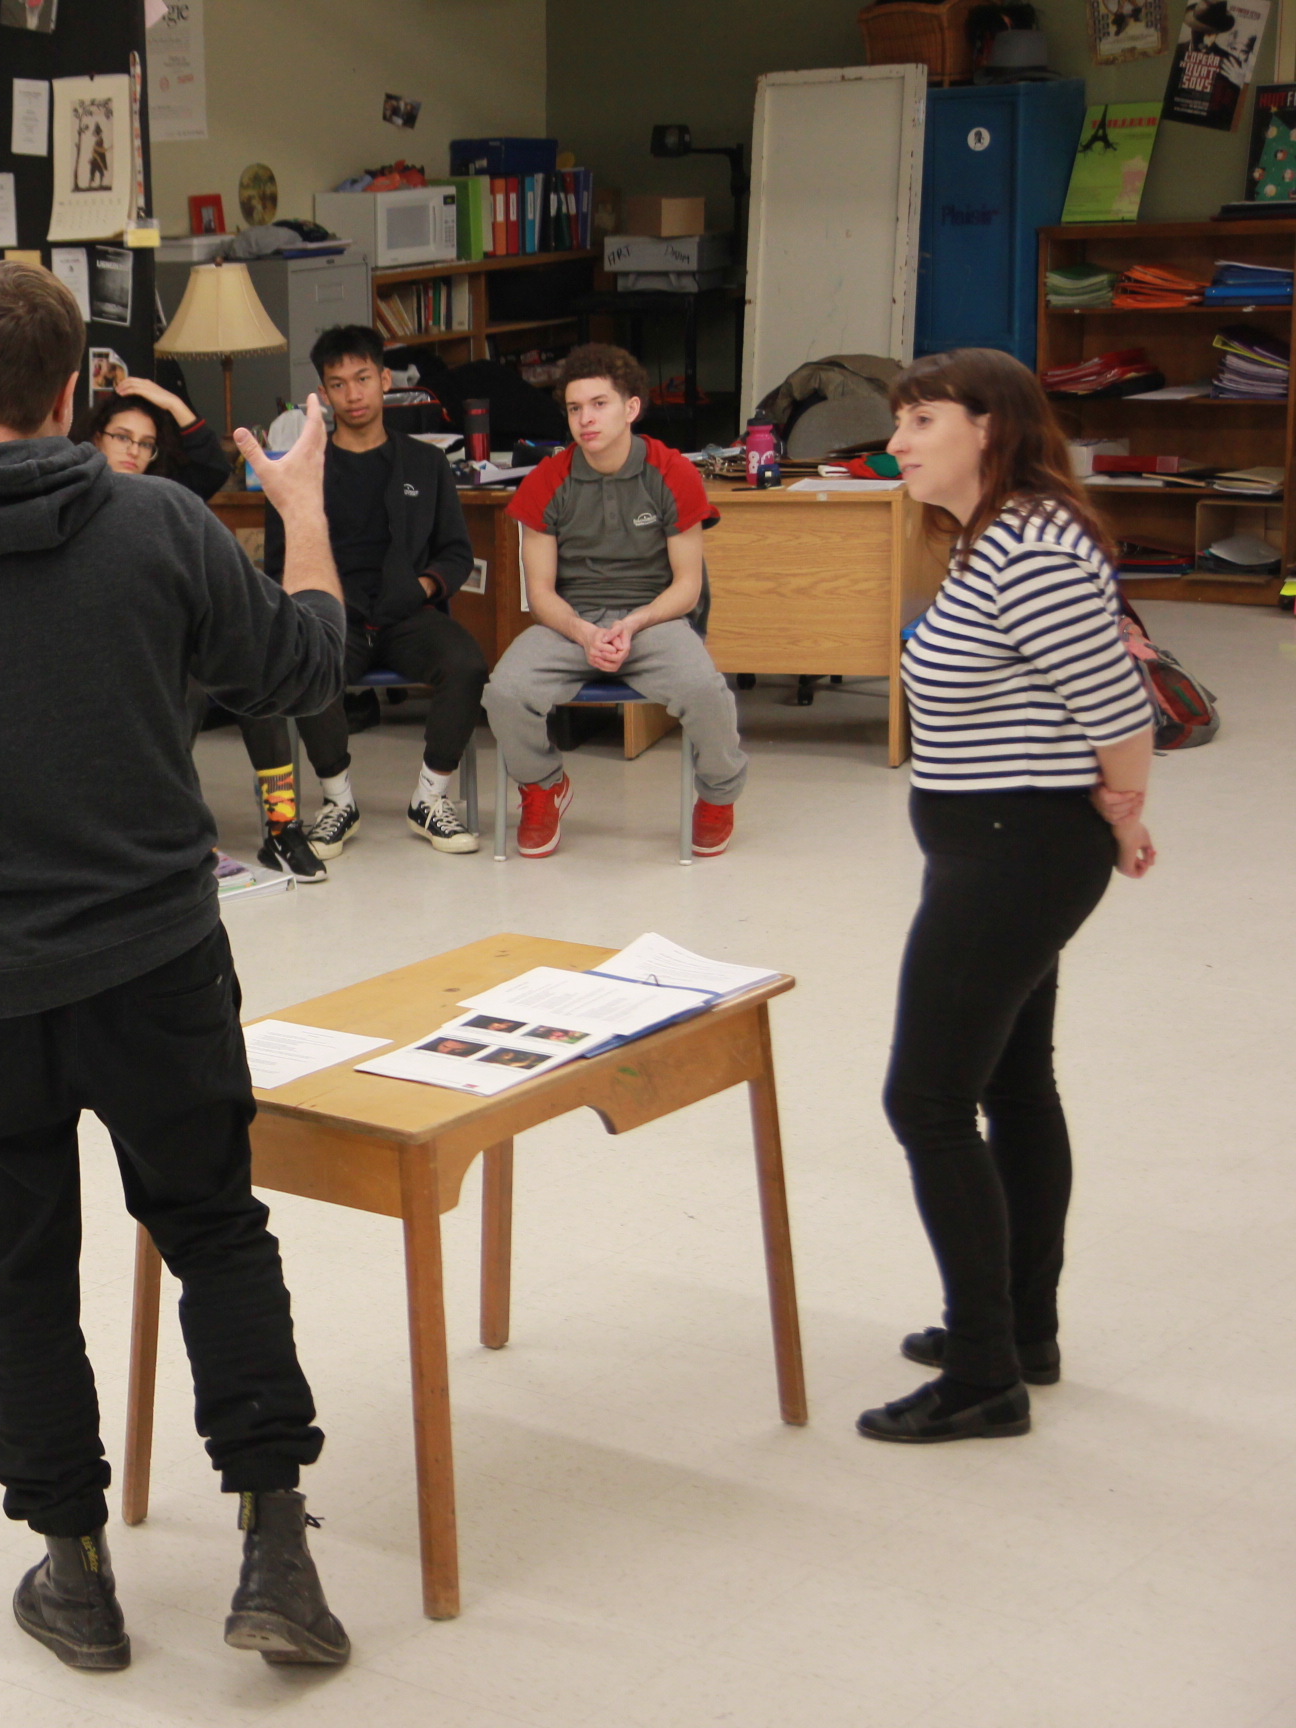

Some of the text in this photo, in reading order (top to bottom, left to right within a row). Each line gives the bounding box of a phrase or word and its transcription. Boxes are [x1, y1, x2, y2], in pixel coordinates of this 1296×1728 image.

[162, 0, 189, 28] gie
[1182, 75, 1213, 93] SOUS
[1091, 117, 1158, 129] TILLEUR
[607, 244, 632, 265] ART
